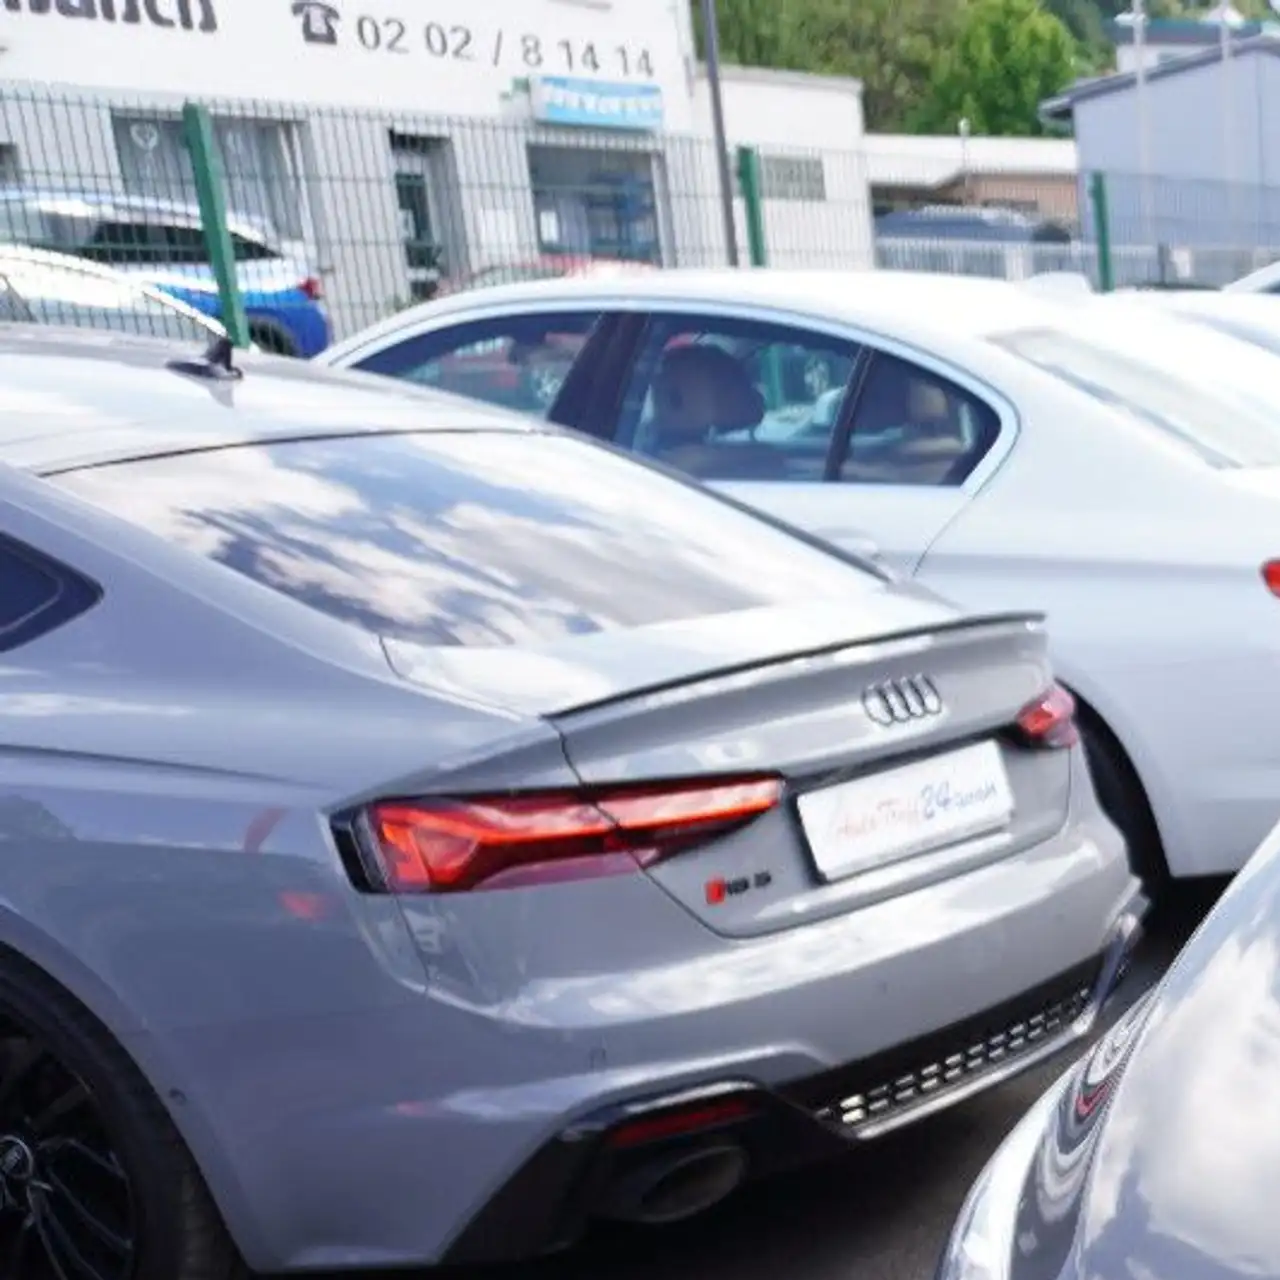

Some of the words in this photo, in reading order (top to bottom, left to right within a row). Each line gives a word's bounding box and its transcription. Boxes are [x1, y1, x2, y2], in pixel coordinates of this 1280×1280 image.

[357, 15, 408, 54] 02
[424, 23, 473, 62] 02
[520, 34, 543, 67] 8
[556, 39, 600, 72] 14
[618, 45, 654, 77] 14
